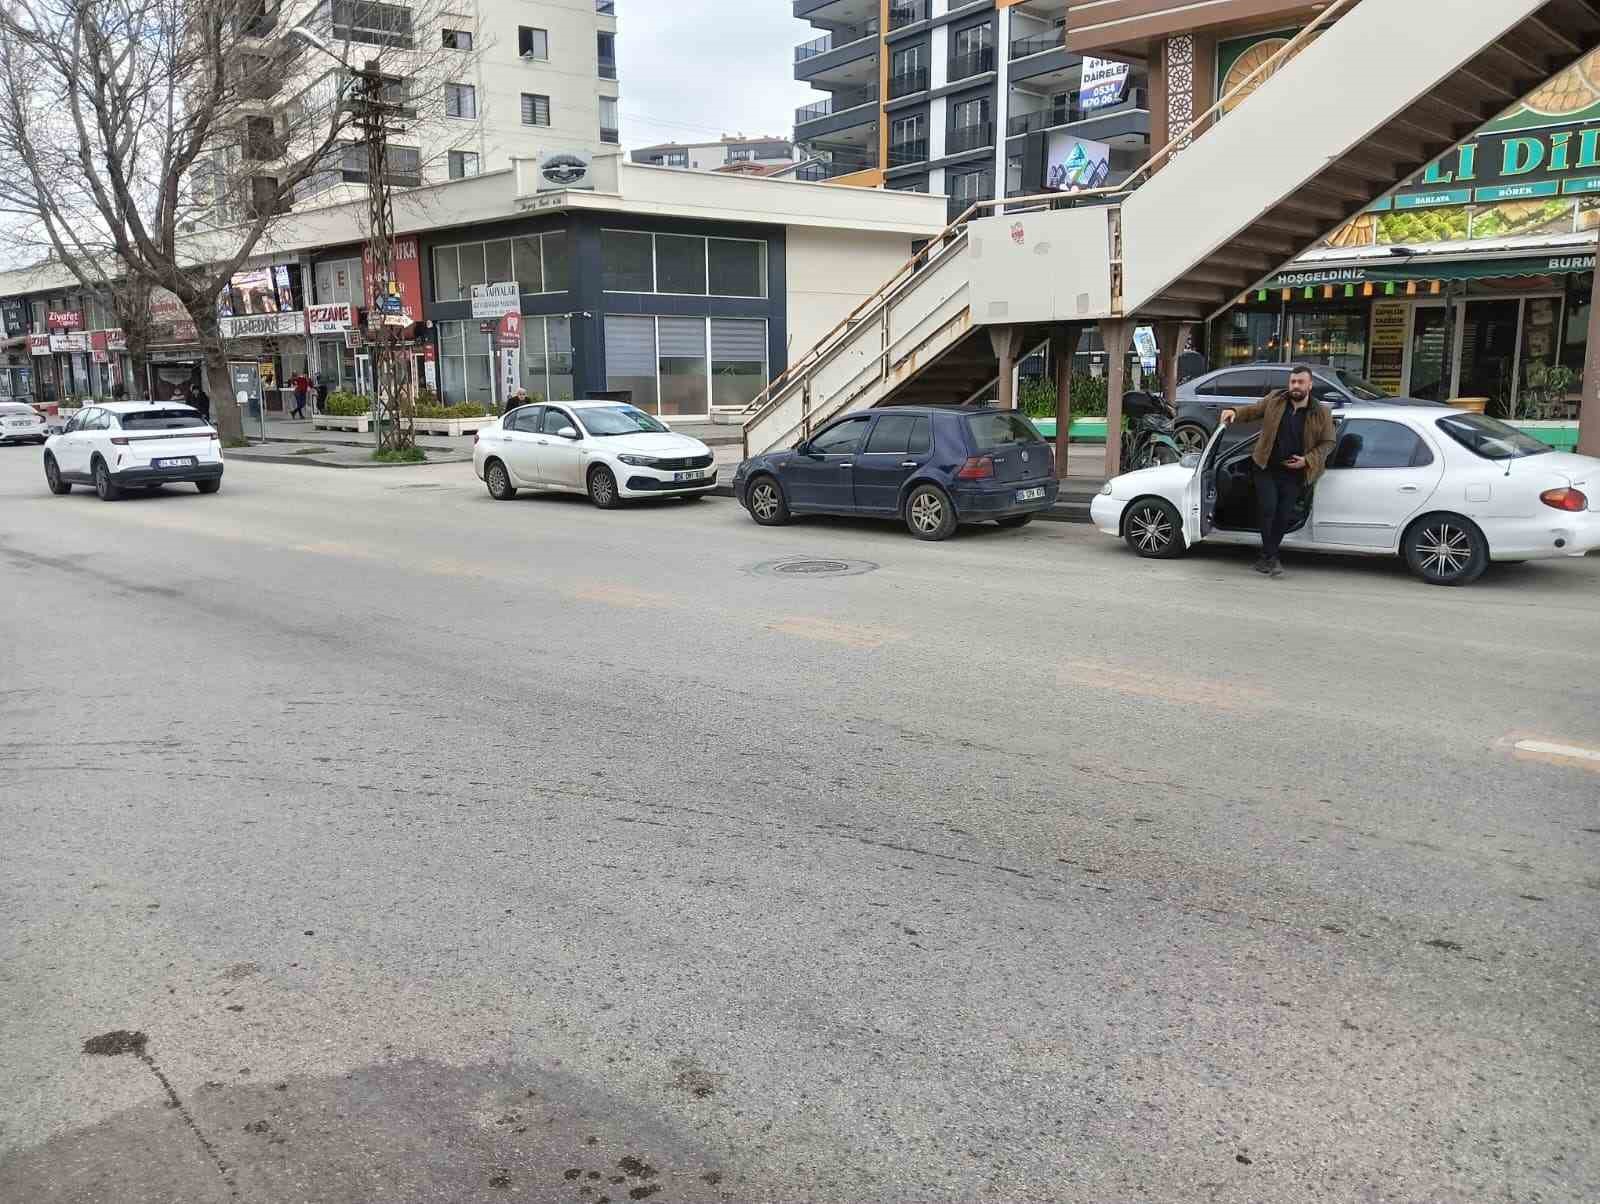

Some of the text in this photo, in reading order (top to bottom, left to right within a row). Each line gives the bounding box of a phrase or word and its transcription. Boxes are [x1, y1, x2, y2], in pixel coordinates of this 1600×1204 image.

[1499, 187, 1532, 196] BÖREK
[1278, 268, 1366, 285] HOŞGELDİNİZ
[49, 311, 79, 322] Ziyafet
[310, 304, 350, 323] ECZANE
